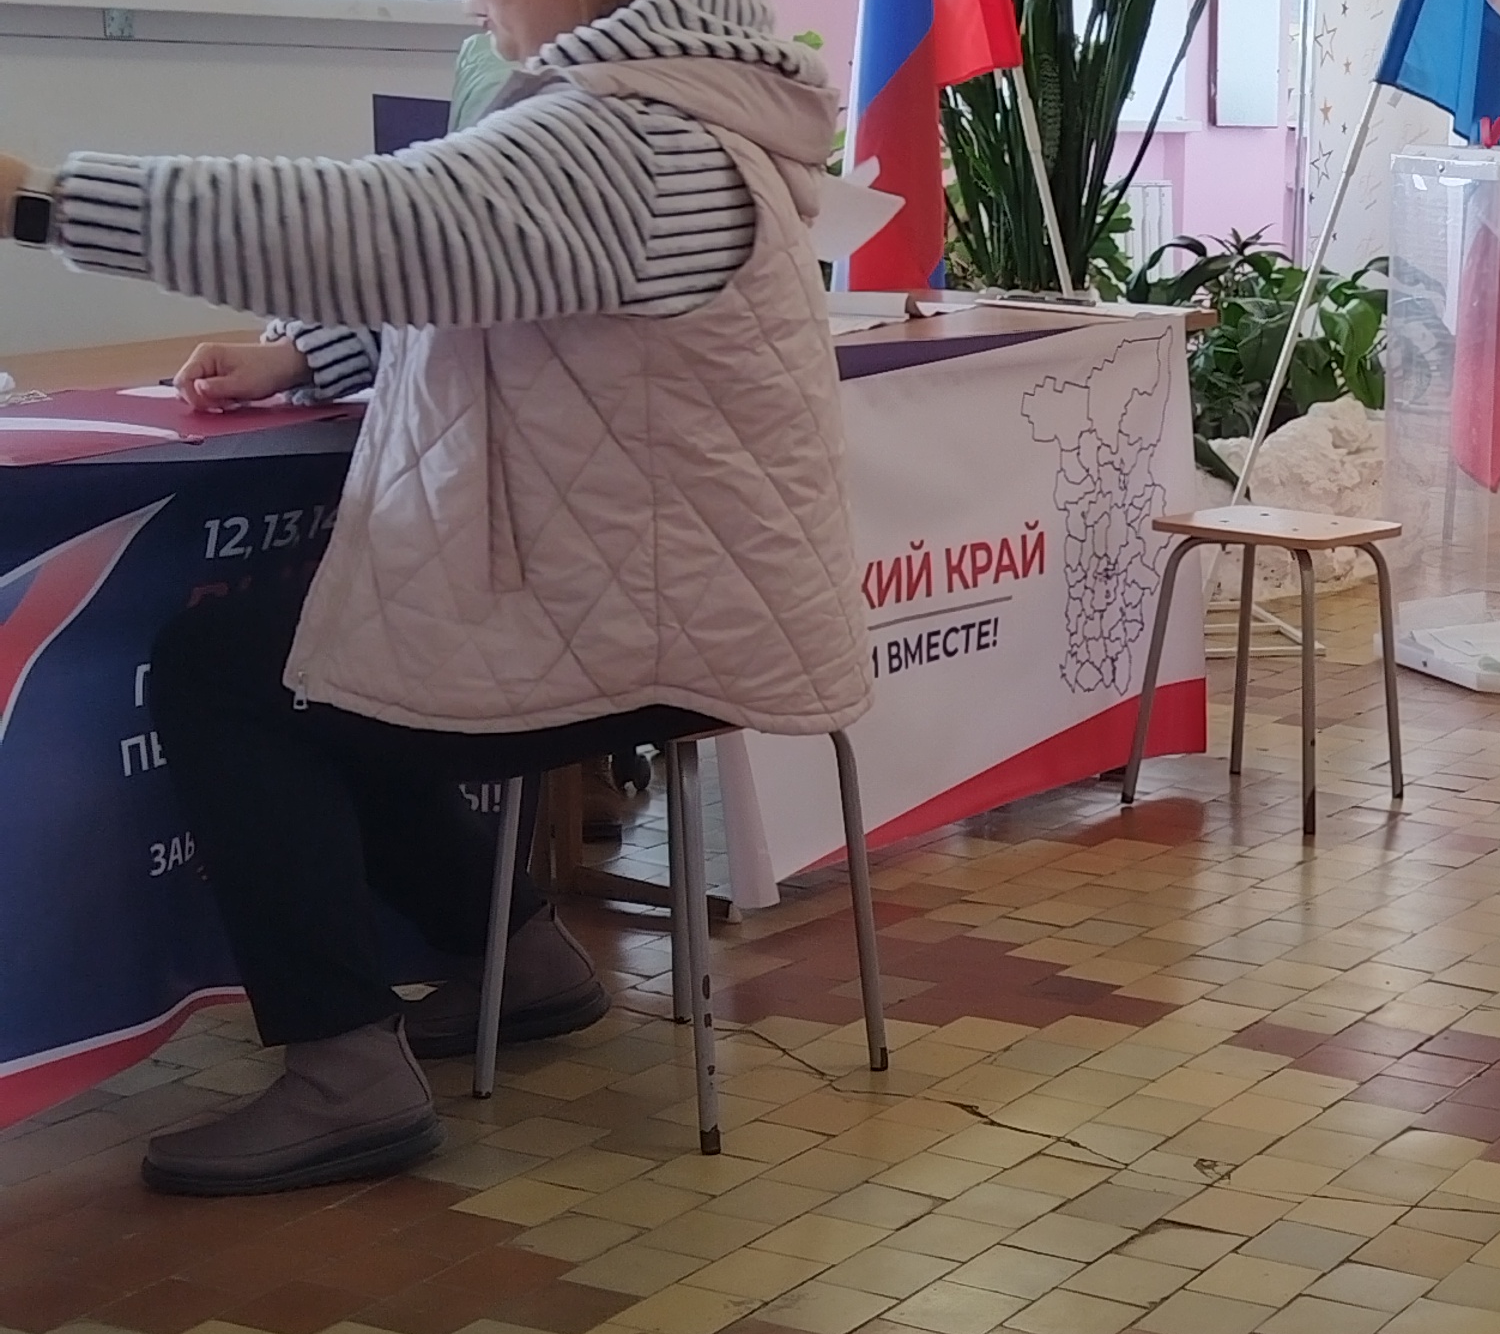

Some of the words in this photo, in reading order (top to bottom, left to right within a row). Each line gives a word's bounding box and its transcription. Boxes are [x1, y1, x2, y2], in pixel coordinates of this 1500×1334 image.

[204, 516, 252, 559] 12,
[945, 520, 1045, 593] КРАЙ
[888, 617, 999, 674] ВМЕСТЕ!
